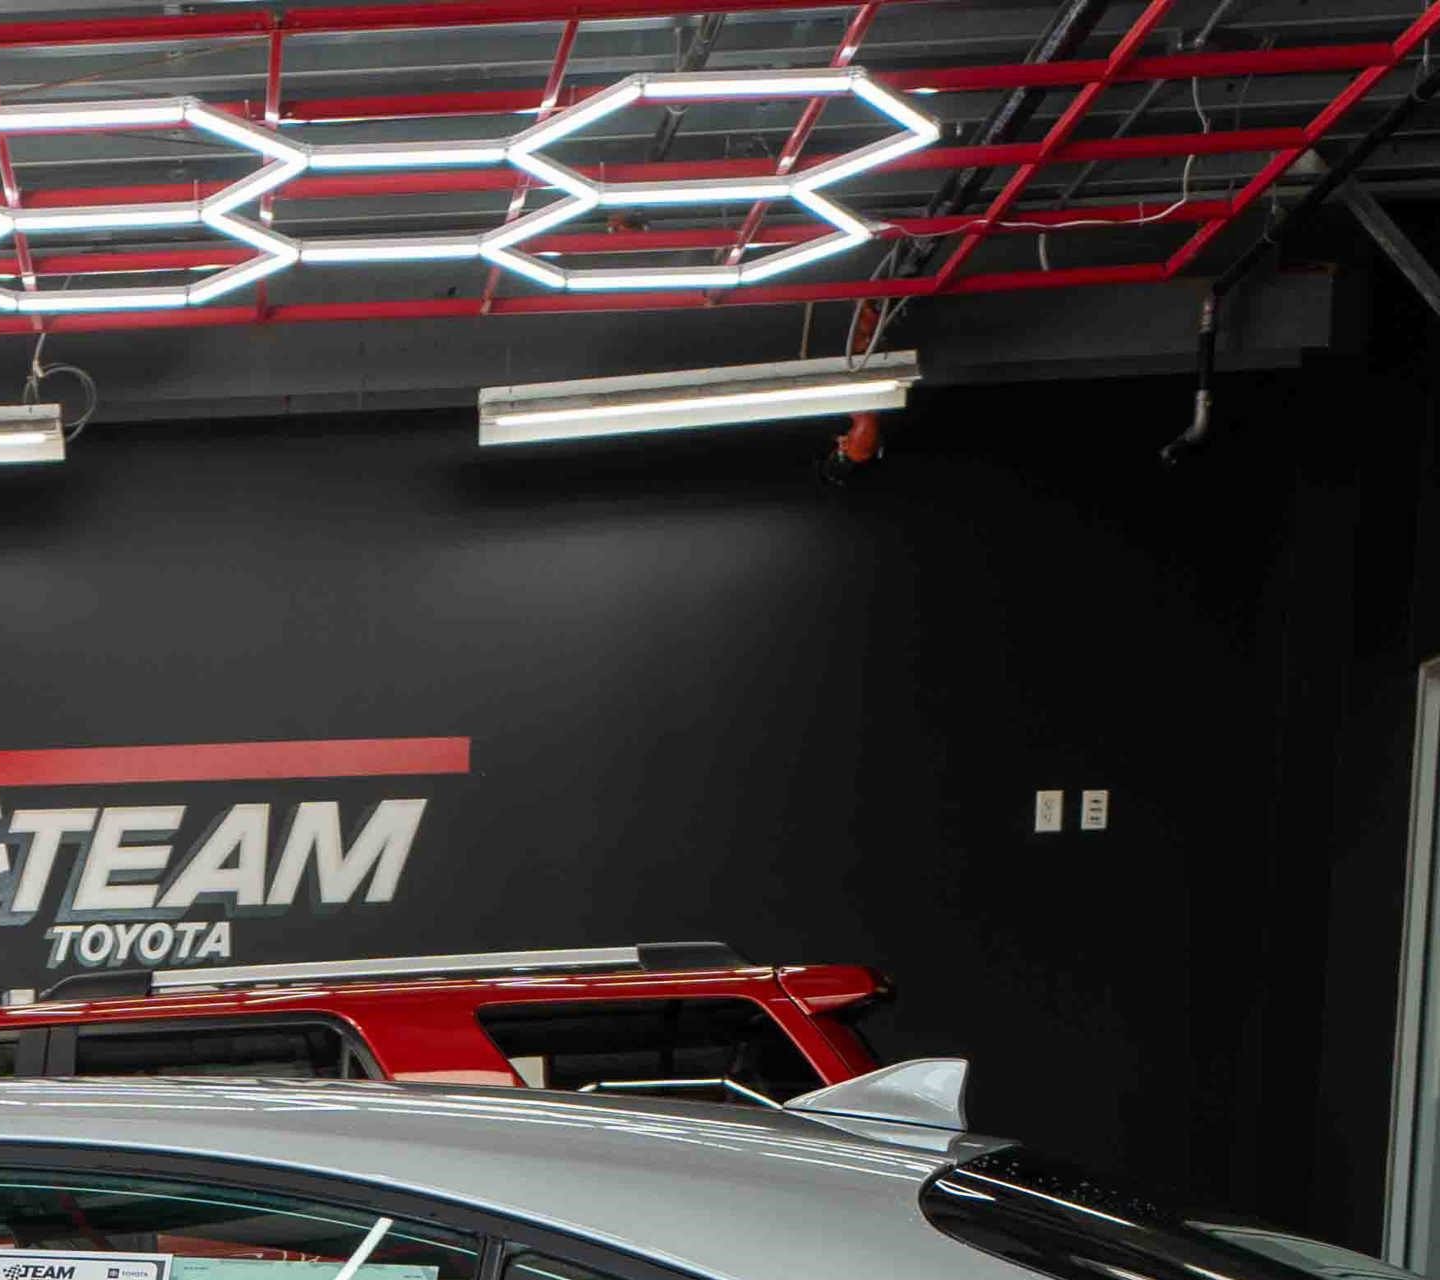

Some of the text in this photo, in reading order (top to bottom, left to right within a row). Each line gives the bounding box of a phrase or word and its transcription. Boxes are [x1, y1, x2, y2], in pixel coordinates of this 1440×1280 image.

[5, 798, 428, 914] TEAM
[49, 921, 232, 967] TOYOTA
[21, 1264, 76, 1280] TEAM
